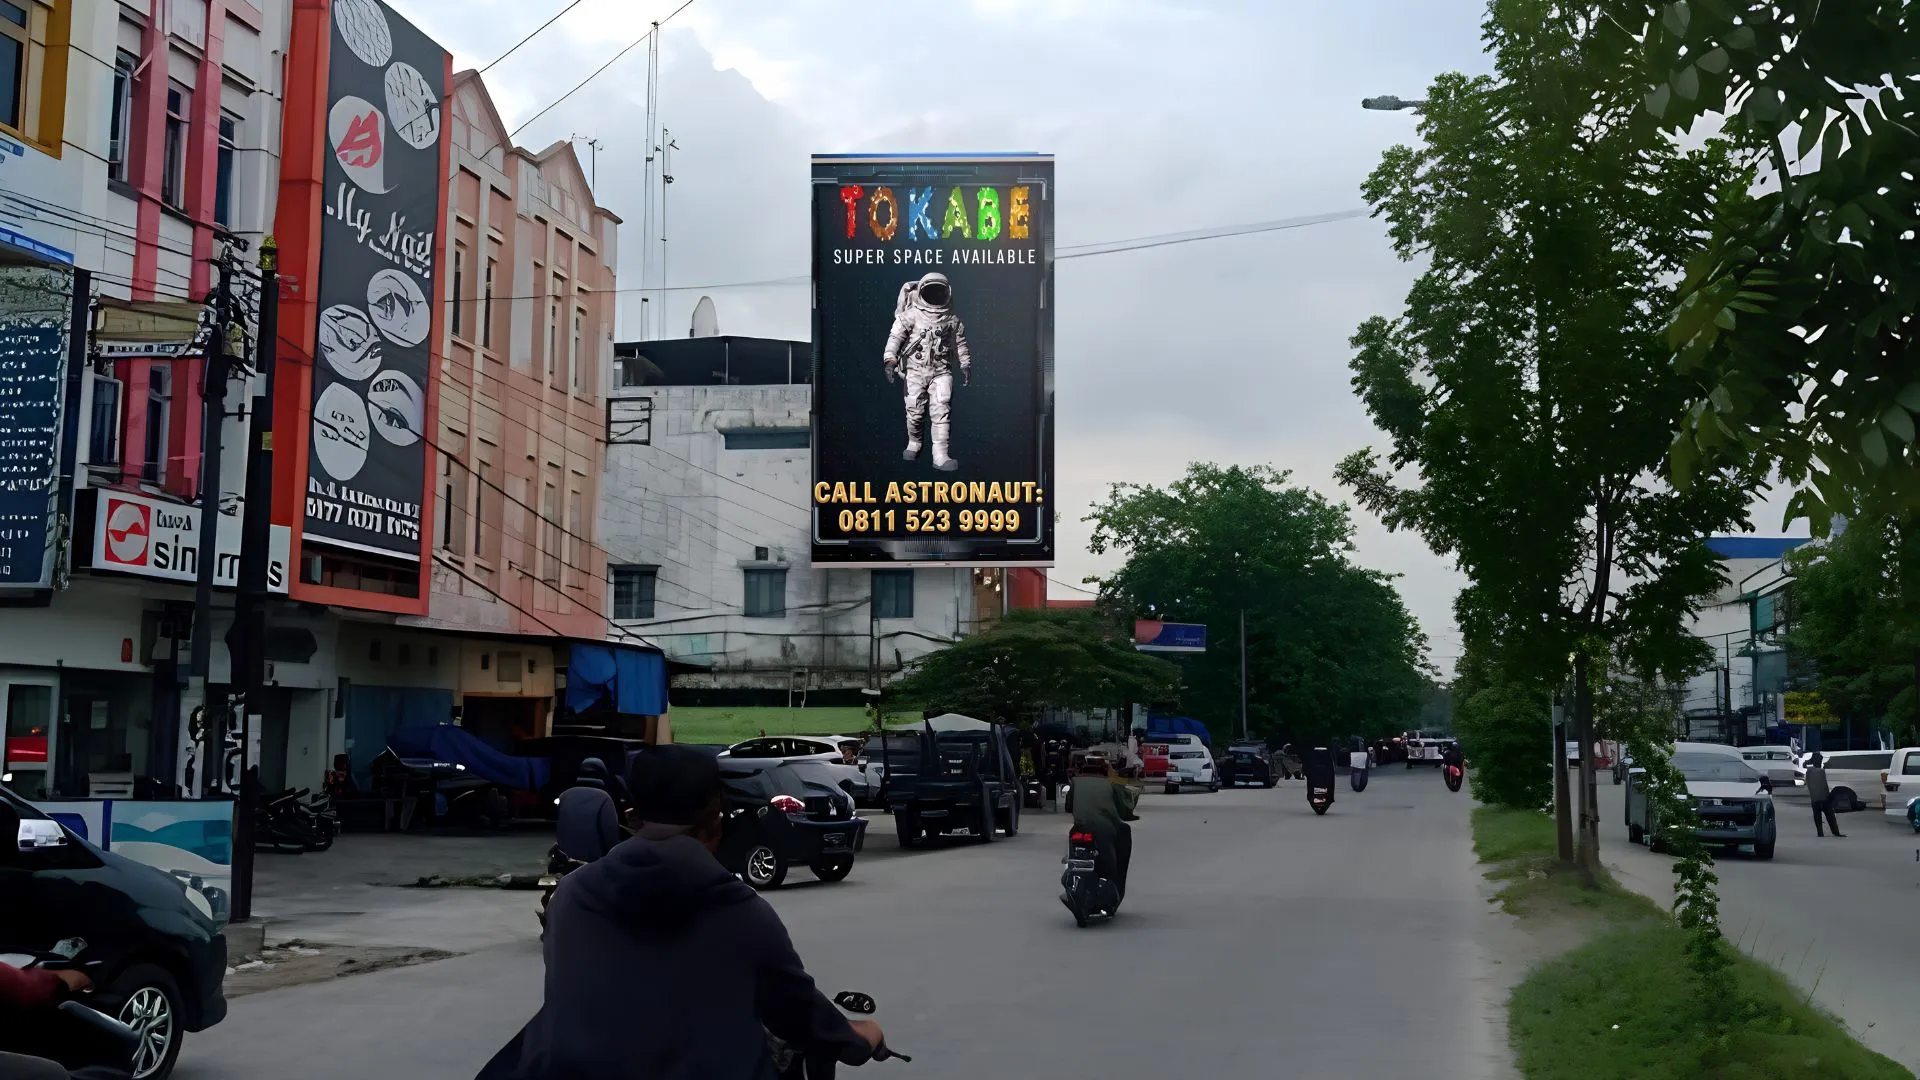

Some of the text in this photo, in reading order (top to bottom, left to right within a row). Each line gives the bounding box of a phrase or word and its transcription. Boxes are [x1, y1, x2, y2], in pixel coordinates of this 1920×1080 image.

[839, 184, 1030, 241] TOKABE
[833, 249, 1036, 264] SUPER SPACE AVAILABLE
[814, 481, 1043, 504] CALL ASTRONAUT:
[838, 509, 1020, 532] 0811 523 9999
